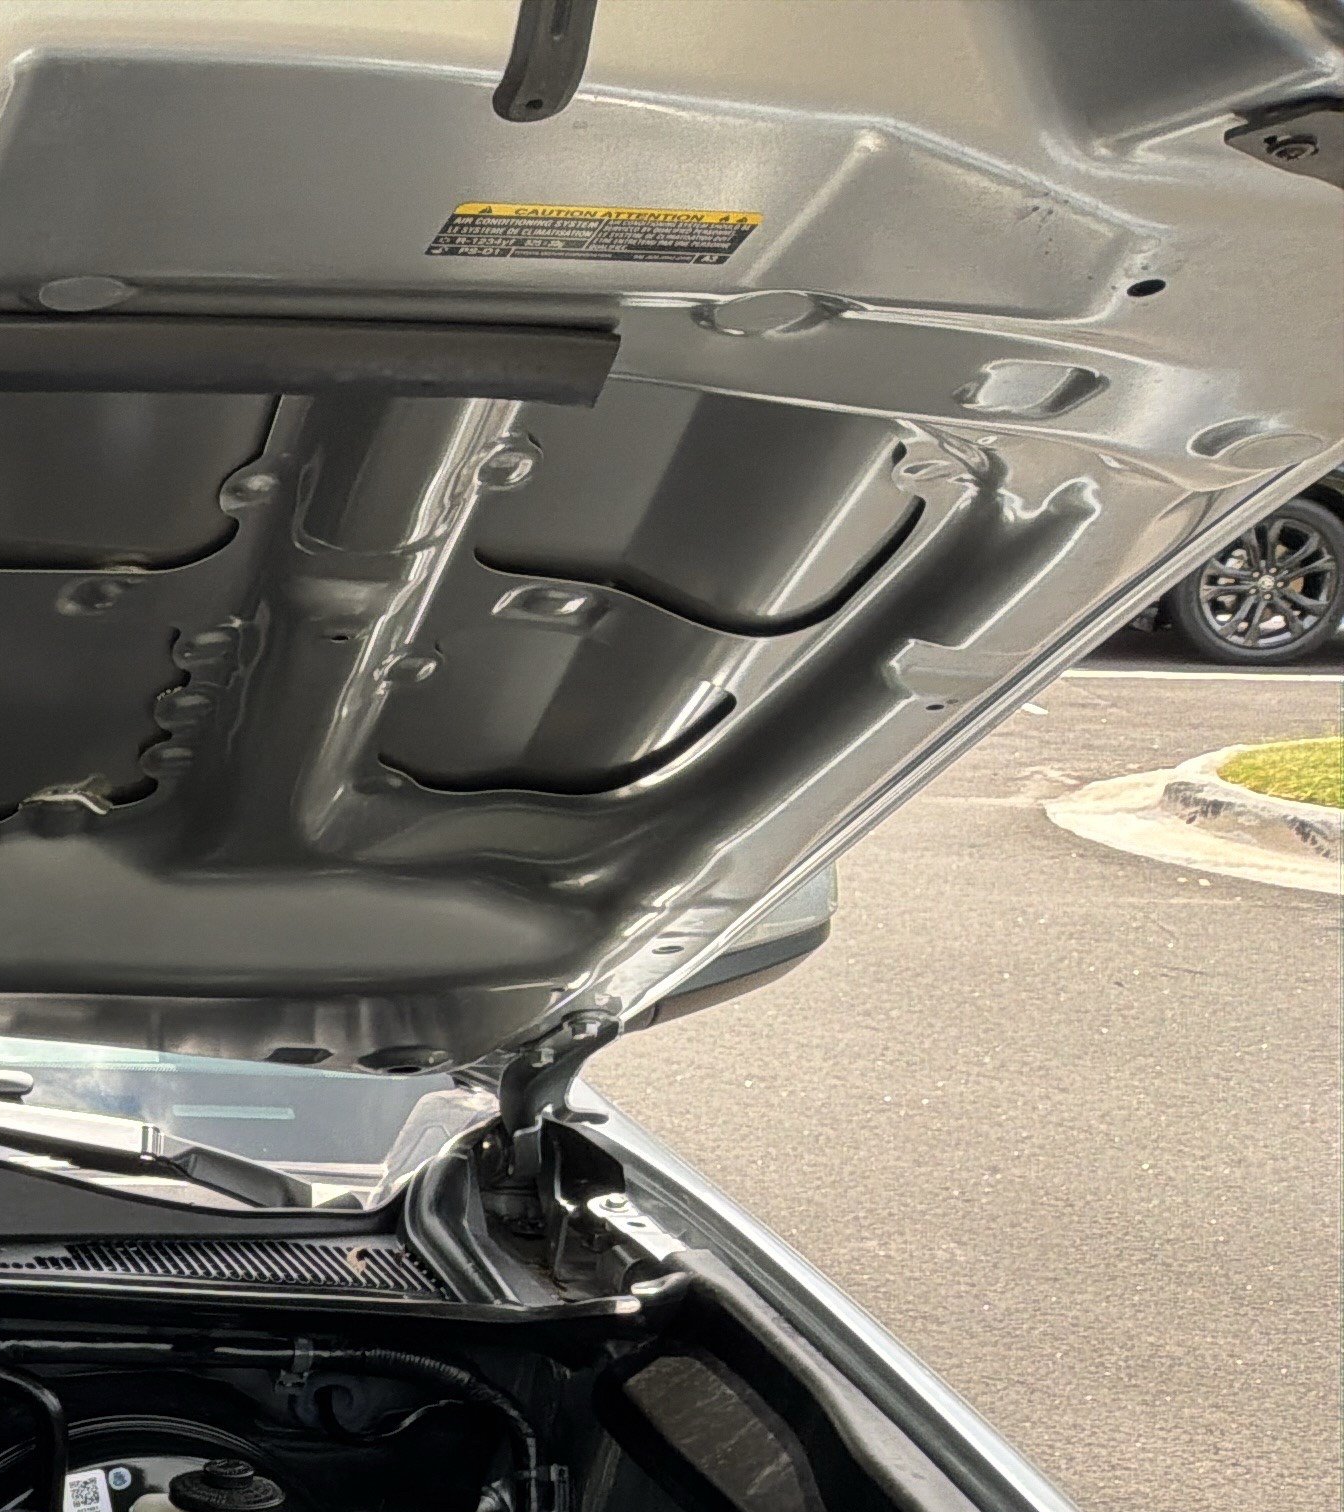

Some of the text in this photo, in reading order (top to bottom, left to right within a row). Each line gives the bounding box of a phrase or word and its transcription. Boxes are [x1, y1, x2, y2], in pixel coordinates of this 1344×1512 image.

[515, 208, 705, 222] CAUTION ATTENTION
[454, 216, 599, 229] AIR CONDITIONING SYSTEM
